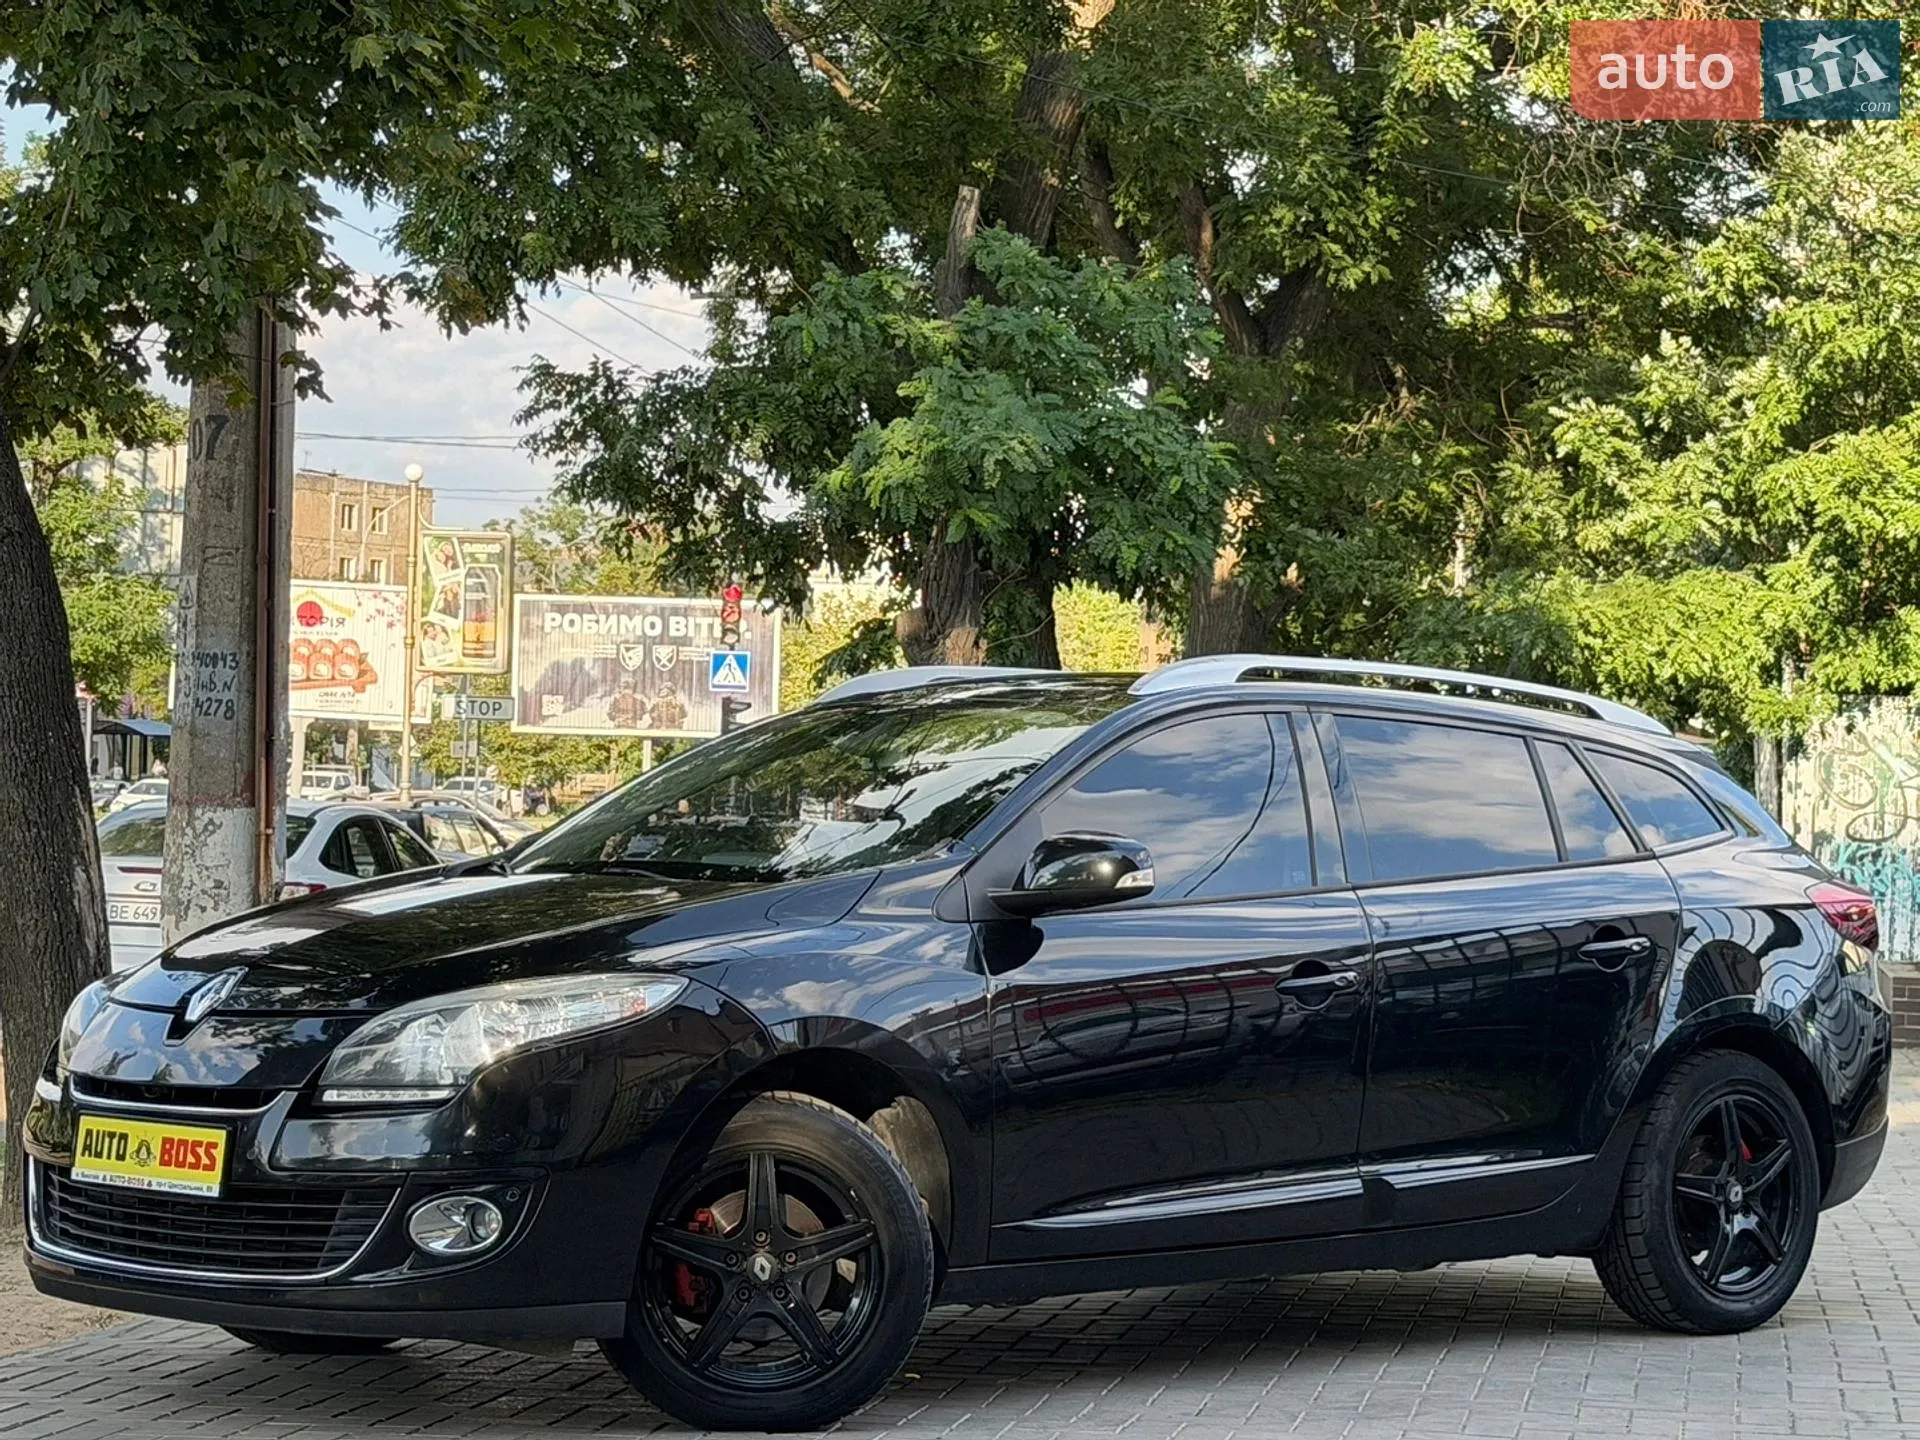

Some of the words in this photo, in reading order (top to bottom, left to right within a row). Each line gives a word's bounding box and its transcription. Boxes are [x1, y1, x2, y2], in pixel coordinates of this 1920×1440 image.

[291, 615, 345, 629] ТОРІЯ
[544, 612, 663, 638] РОБИМО
[194, 696, 236, 721] 4278
[455, 699, 503, 717] STOP
[109, 904, 129, 920] BE
[132, 905, 158, 921] 649
[80, 1127, 130, 1162] AUTO
[158, 1135, 219, 1172] BOSS
